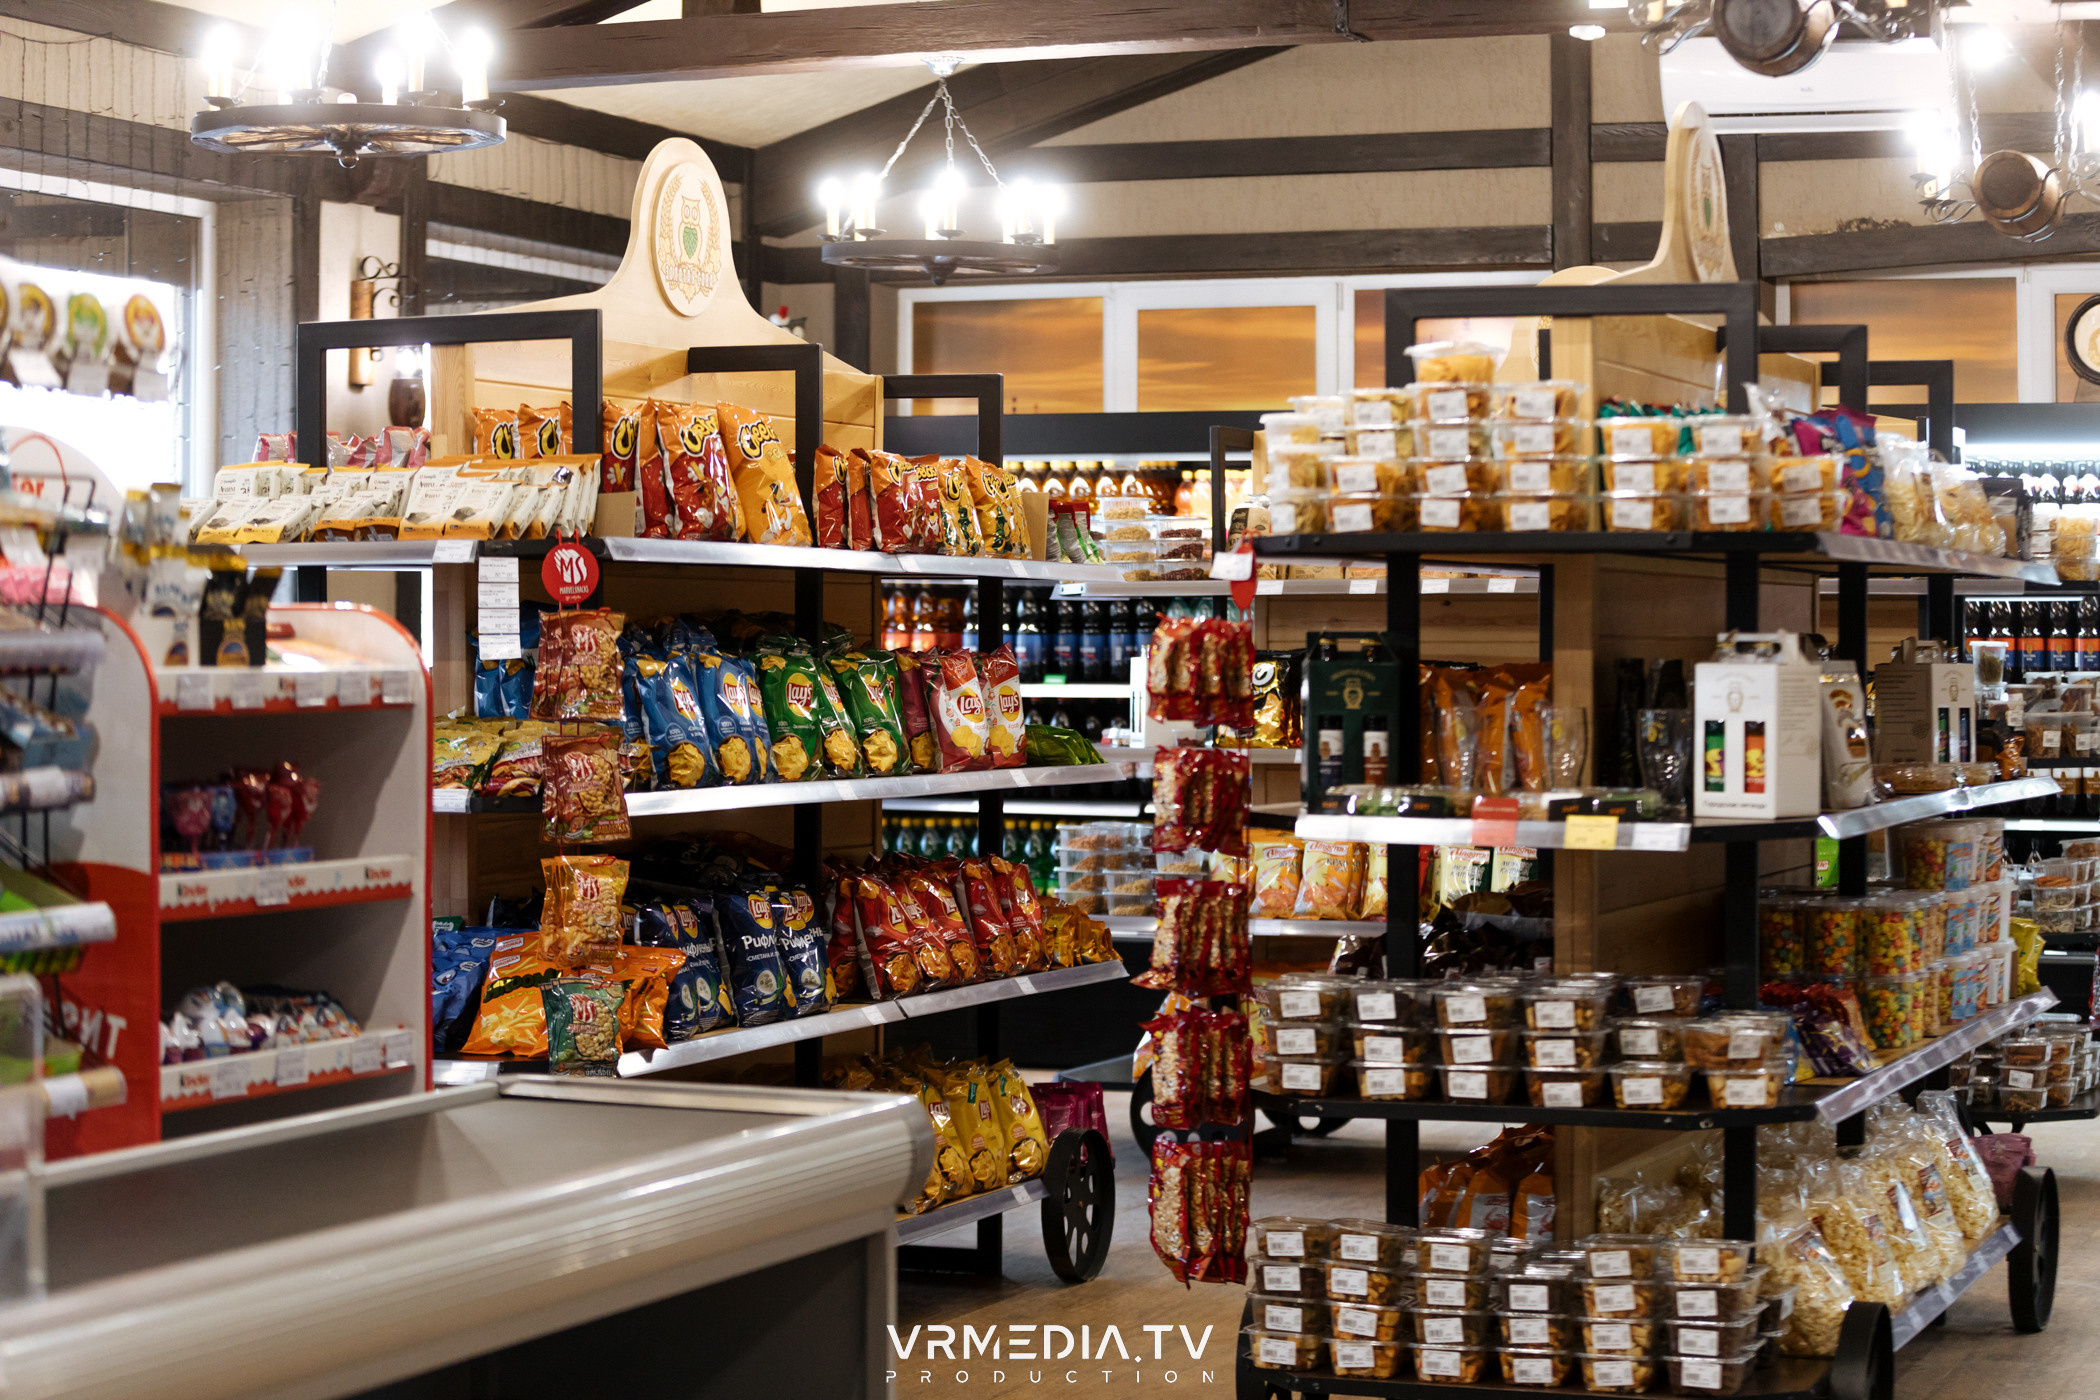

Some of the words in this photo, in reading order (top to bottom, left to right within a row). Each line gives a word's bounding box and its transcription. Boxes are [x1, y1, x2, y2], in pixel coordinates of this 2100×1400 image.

[788, 683, 813, 707] Lay's
[1000, 693, 1019, 713] Lay's
[751, 900, 769, 919] Lay's
